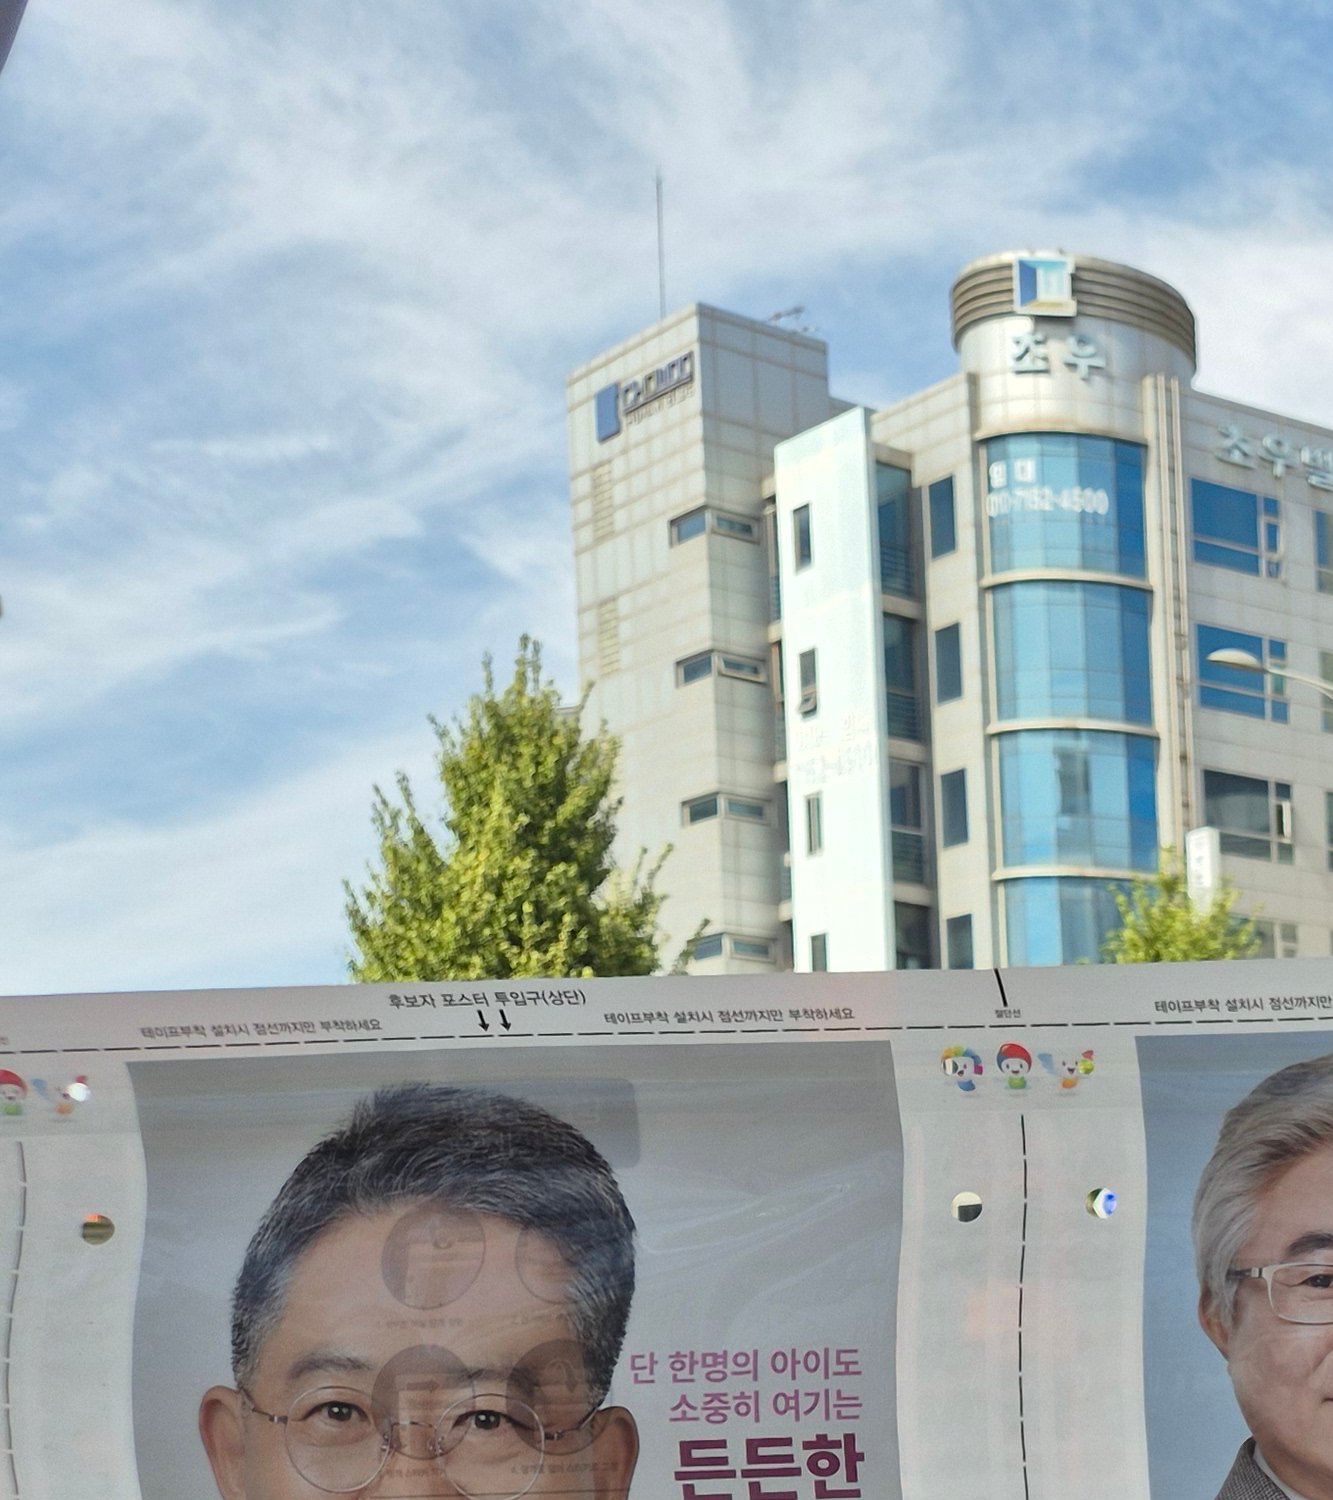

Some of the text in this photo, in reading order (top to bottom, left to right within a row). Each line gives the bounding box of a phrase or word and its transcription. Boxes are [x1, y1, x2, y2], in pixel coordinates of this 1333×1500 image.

[1010, 331, 1107, 379] 초우
[389, 990, 585, 1009] 후보자 포스터 투입구(상단)
[630, 1348, 862, 1384] 단 한명의 아이도
[669, 1388, 863, 1424] 소중히 여기는
